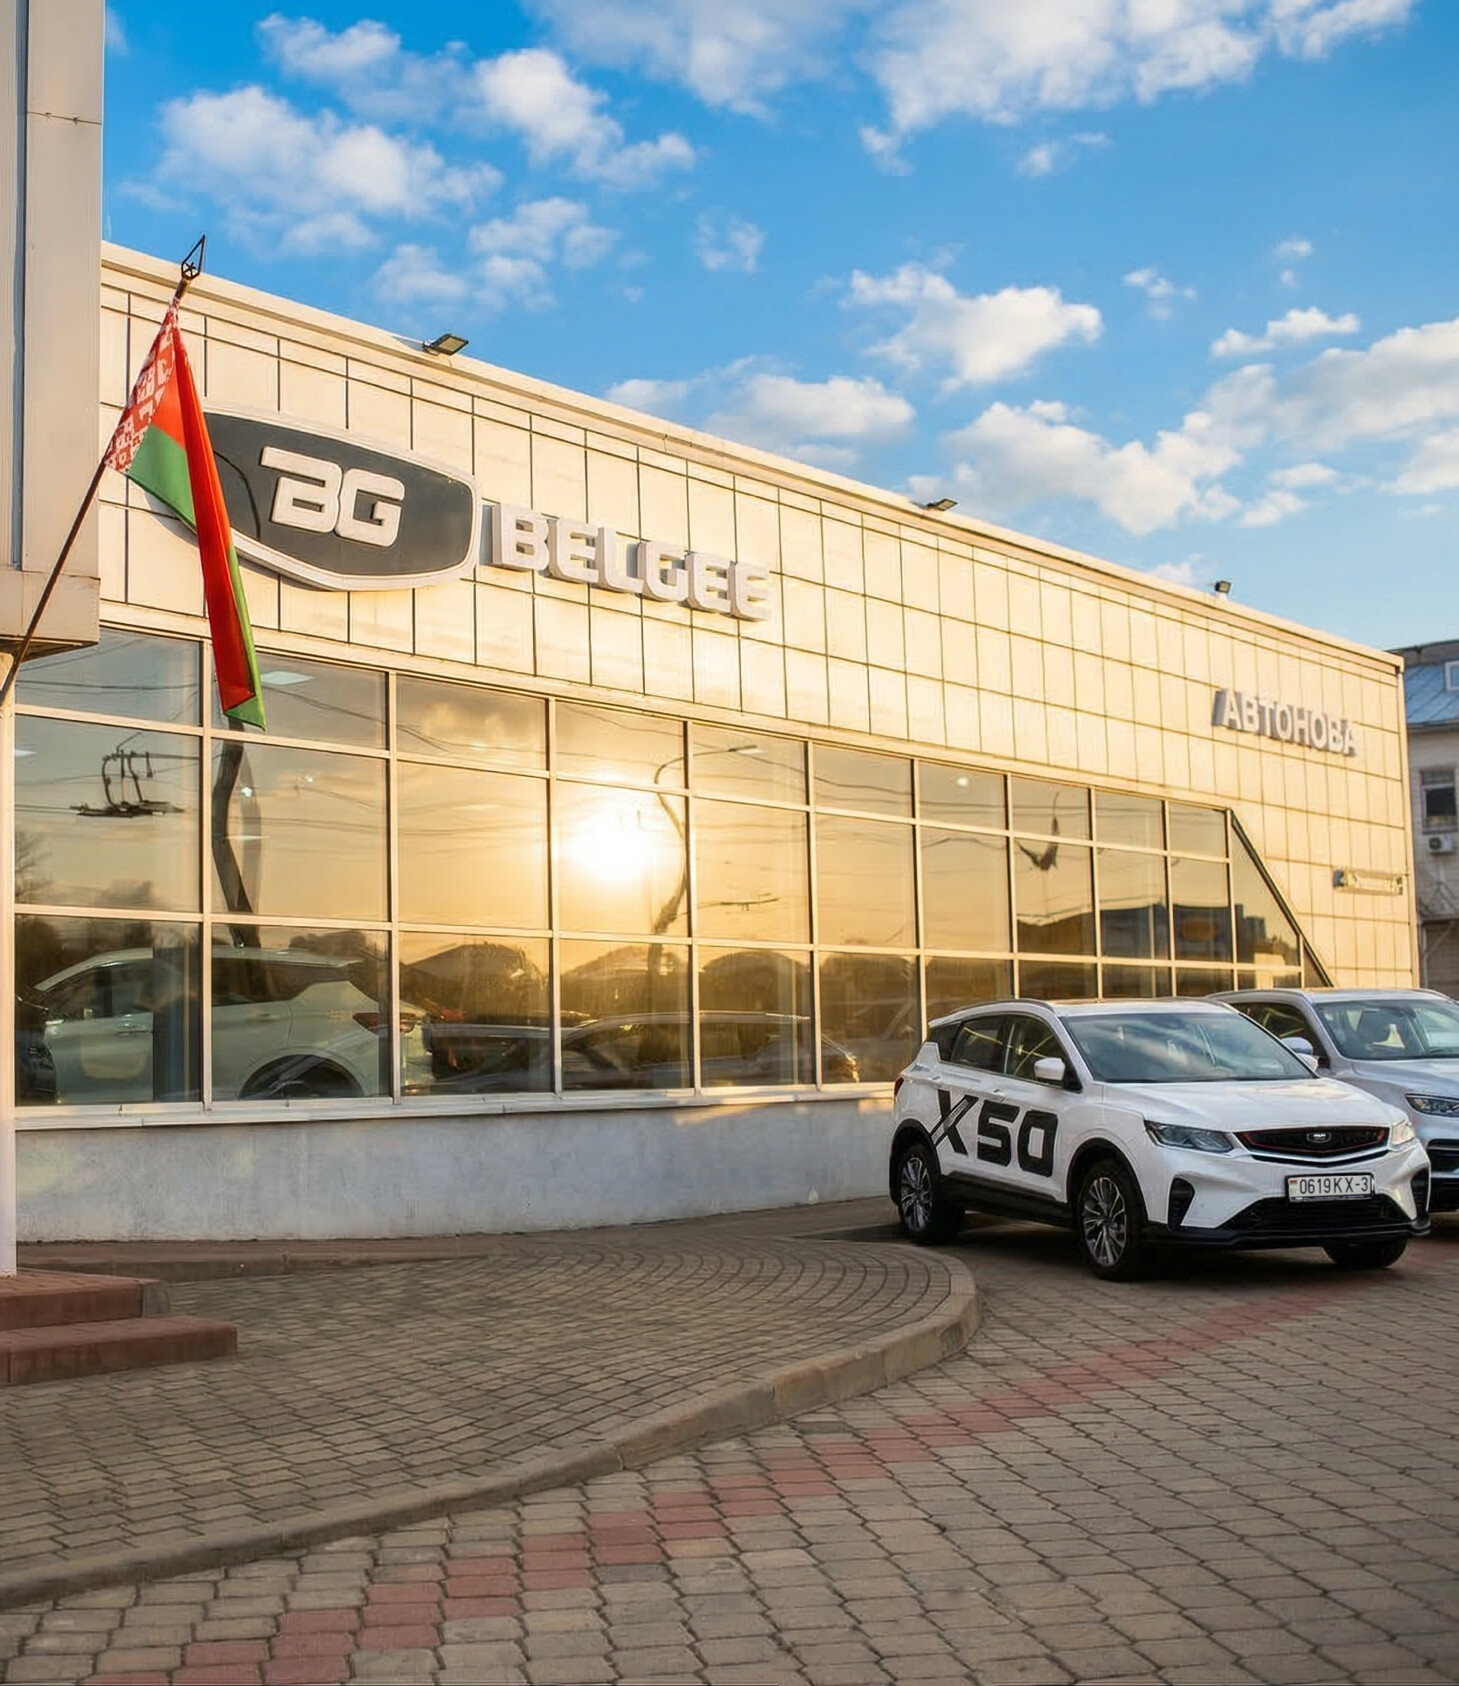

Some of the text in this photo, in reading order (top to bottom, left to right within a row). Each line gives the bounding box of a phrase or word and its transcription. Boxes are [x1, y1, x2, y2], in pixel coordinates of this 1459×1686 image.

[261, 446, 405, 547] BG
[491, 503, 772, 622] BELGEE
[1217, 688, 1358, 757] АВТОНОВА
[929, 1089, 1059, 1178] X50
